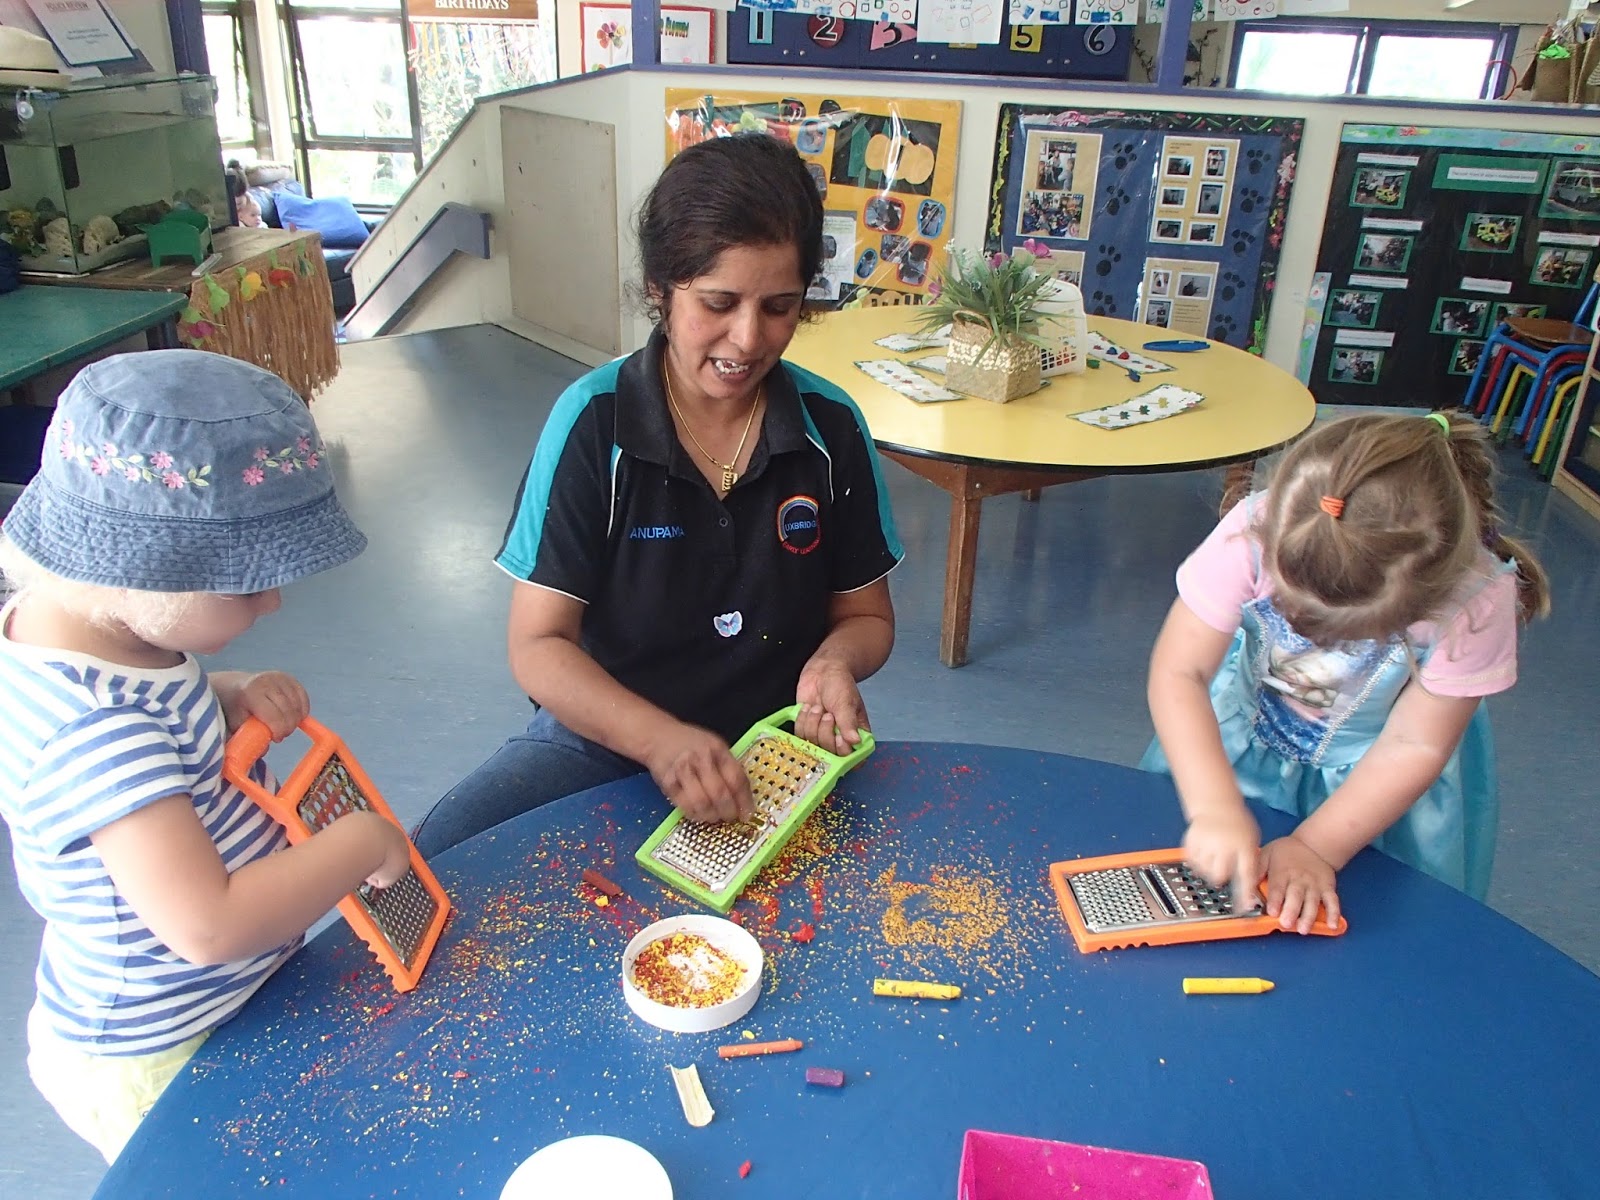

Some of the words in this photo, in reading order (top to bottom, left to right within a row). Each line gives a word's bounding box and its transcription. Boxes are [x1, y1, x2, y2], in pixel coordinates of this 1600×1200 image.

[435, 0, 509, 10] BIRTHDAYS
[756, 11, 765, 40] 1
[812, 14, 838, 41] 2
[1014, 25, 1033, 48] 5
[1088, 25, 1107, 52] 6
[630, 526, 686, 539] ANUPAMA
[784, 520, 818, 532] UXBRIDG
